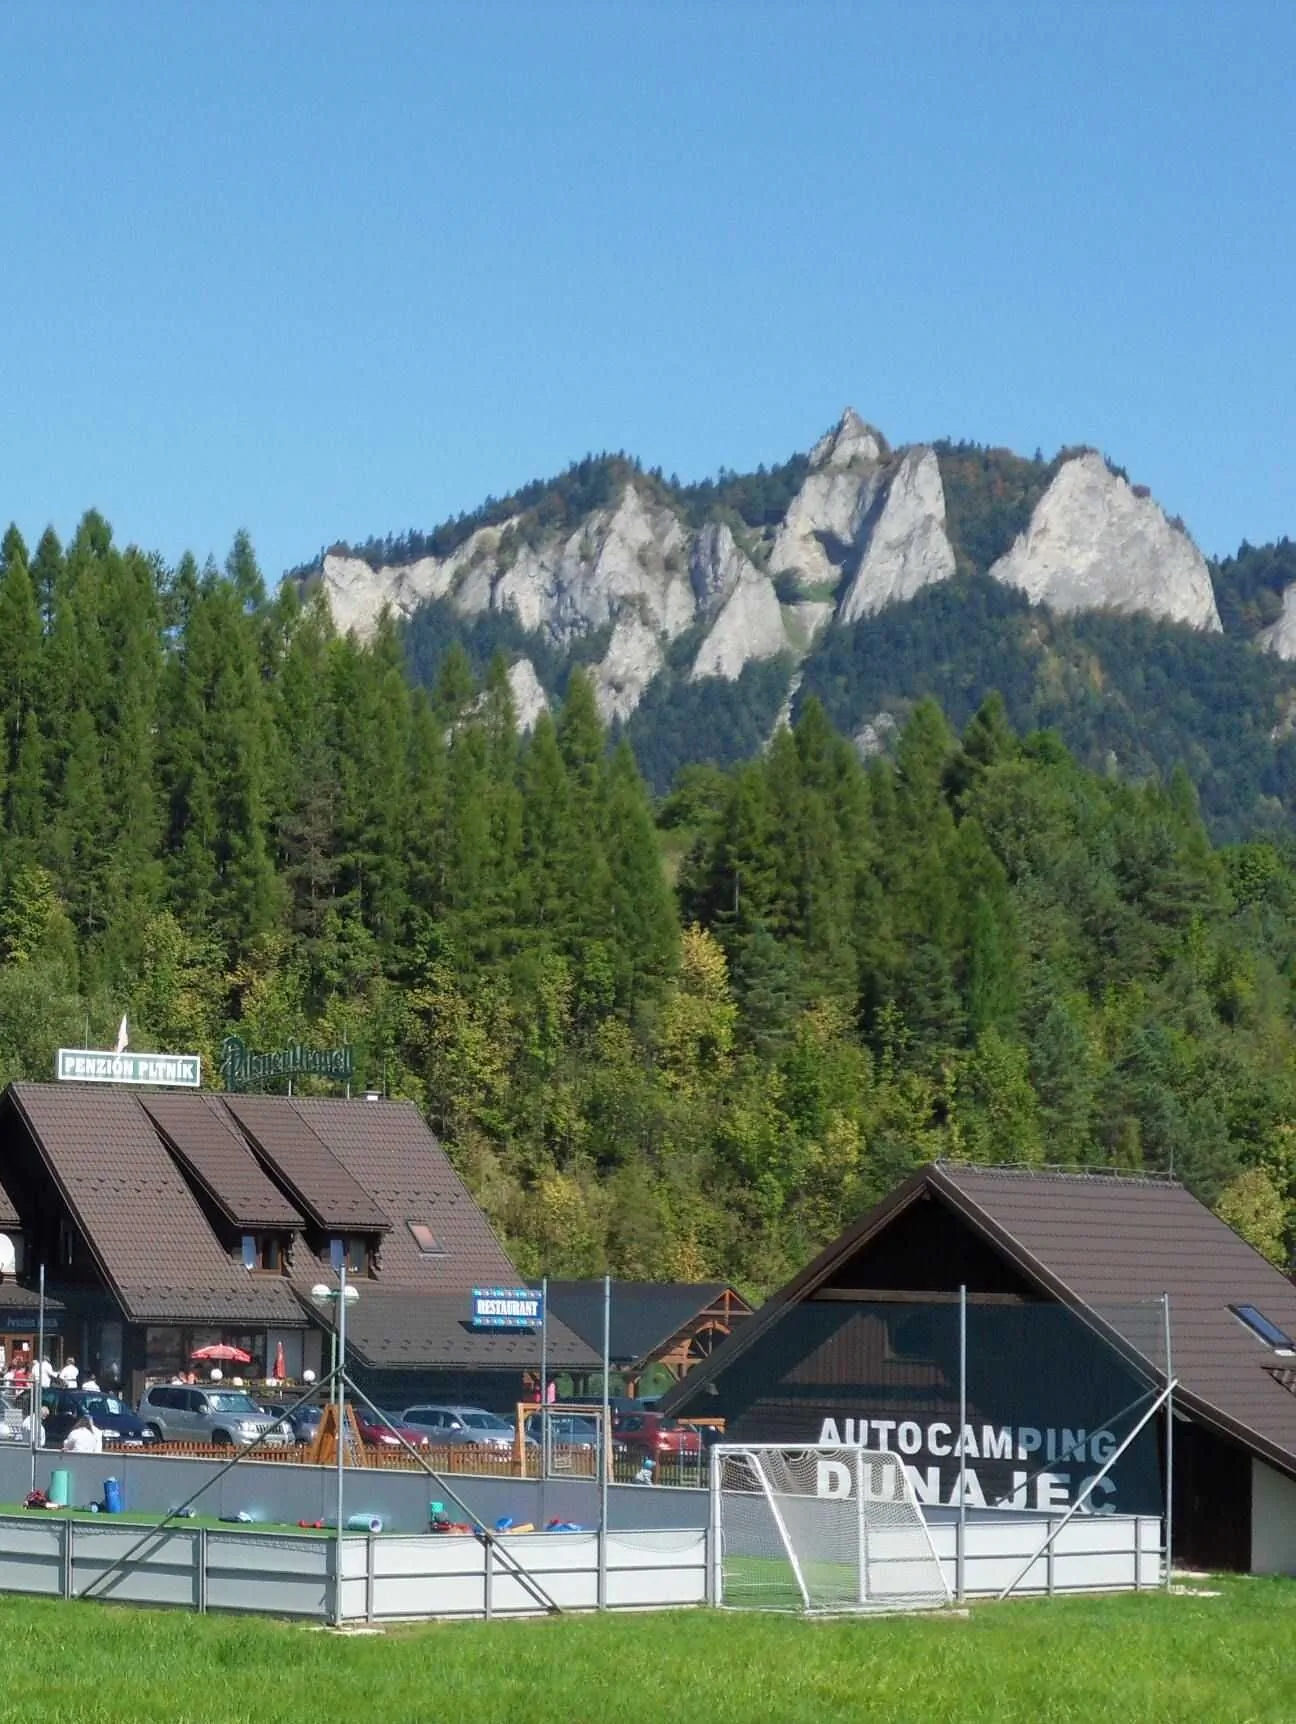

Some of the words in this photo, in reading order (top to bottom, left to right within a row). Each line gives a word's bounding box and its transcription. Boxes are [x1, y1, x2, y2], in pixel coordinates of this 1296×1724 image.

[476, 1299, 538, 1317] RESTAURANT
[818, 1417, 1117, 1465] AUTOCAMPING
[816, 1460, 1117, 1515] DUNAJEC
